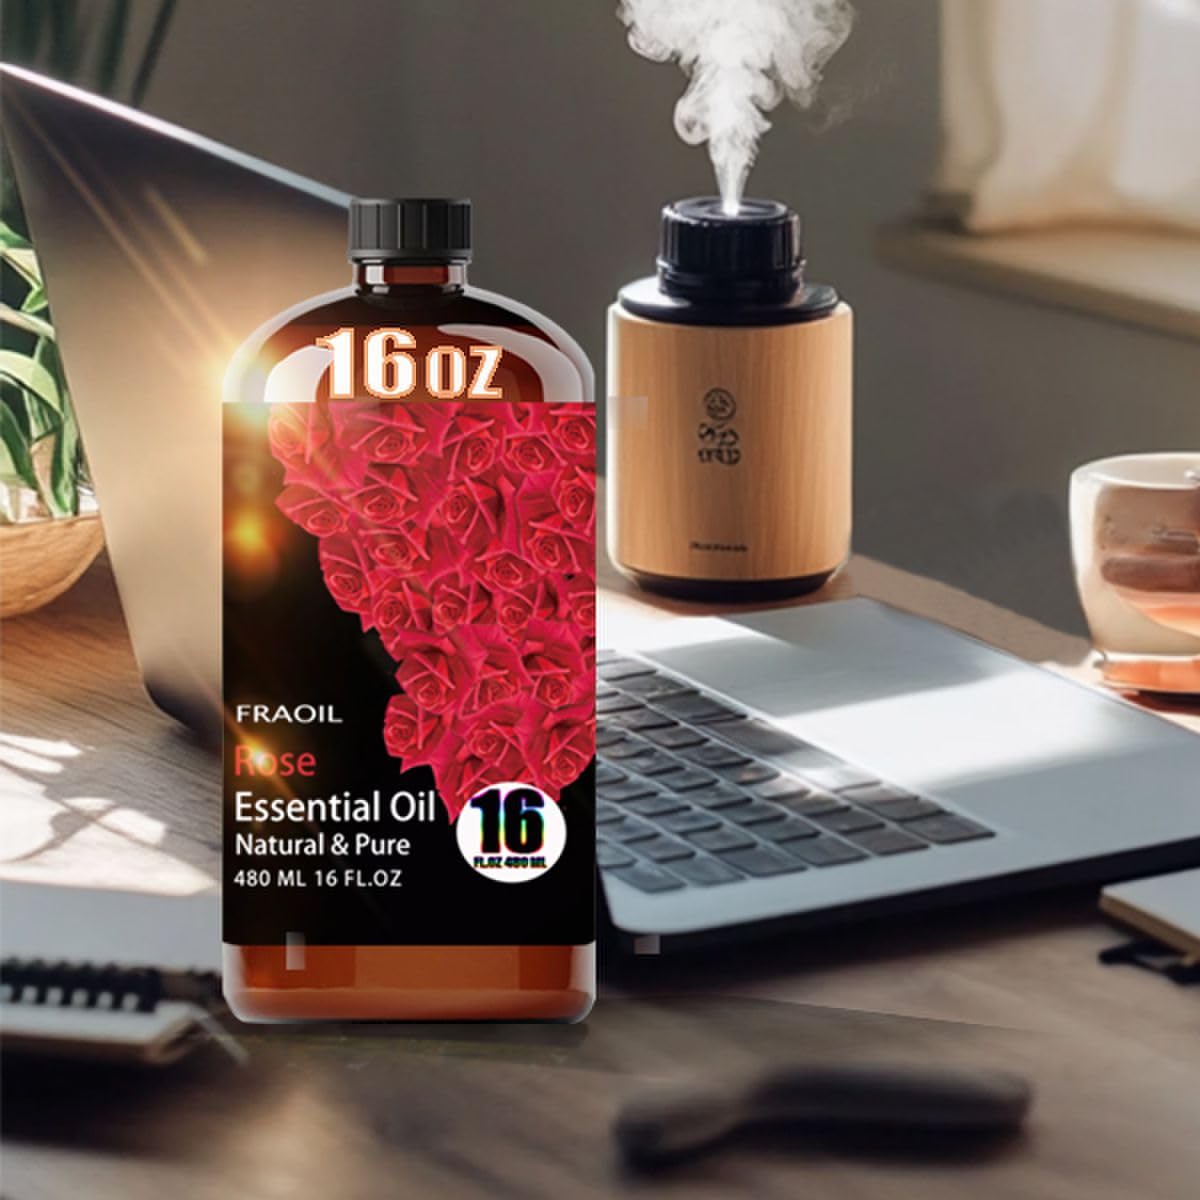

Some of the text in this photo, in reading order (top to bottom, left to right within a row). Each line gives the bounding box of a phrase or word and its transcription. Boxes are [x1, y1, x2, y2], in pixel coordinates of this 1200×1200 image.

[315, 327, 417, 400] 16
[236, 704, 343, 723] FRAOIL
[234, 744, 317, 777] Rose
[235, 790, 436, 823] Essential Oil
[470, 788, 545, 854] 16
[235, 833, 411, 857] Natural & Pure
[234, 869, 403, 887] 480 ML 16 FL.OZ
